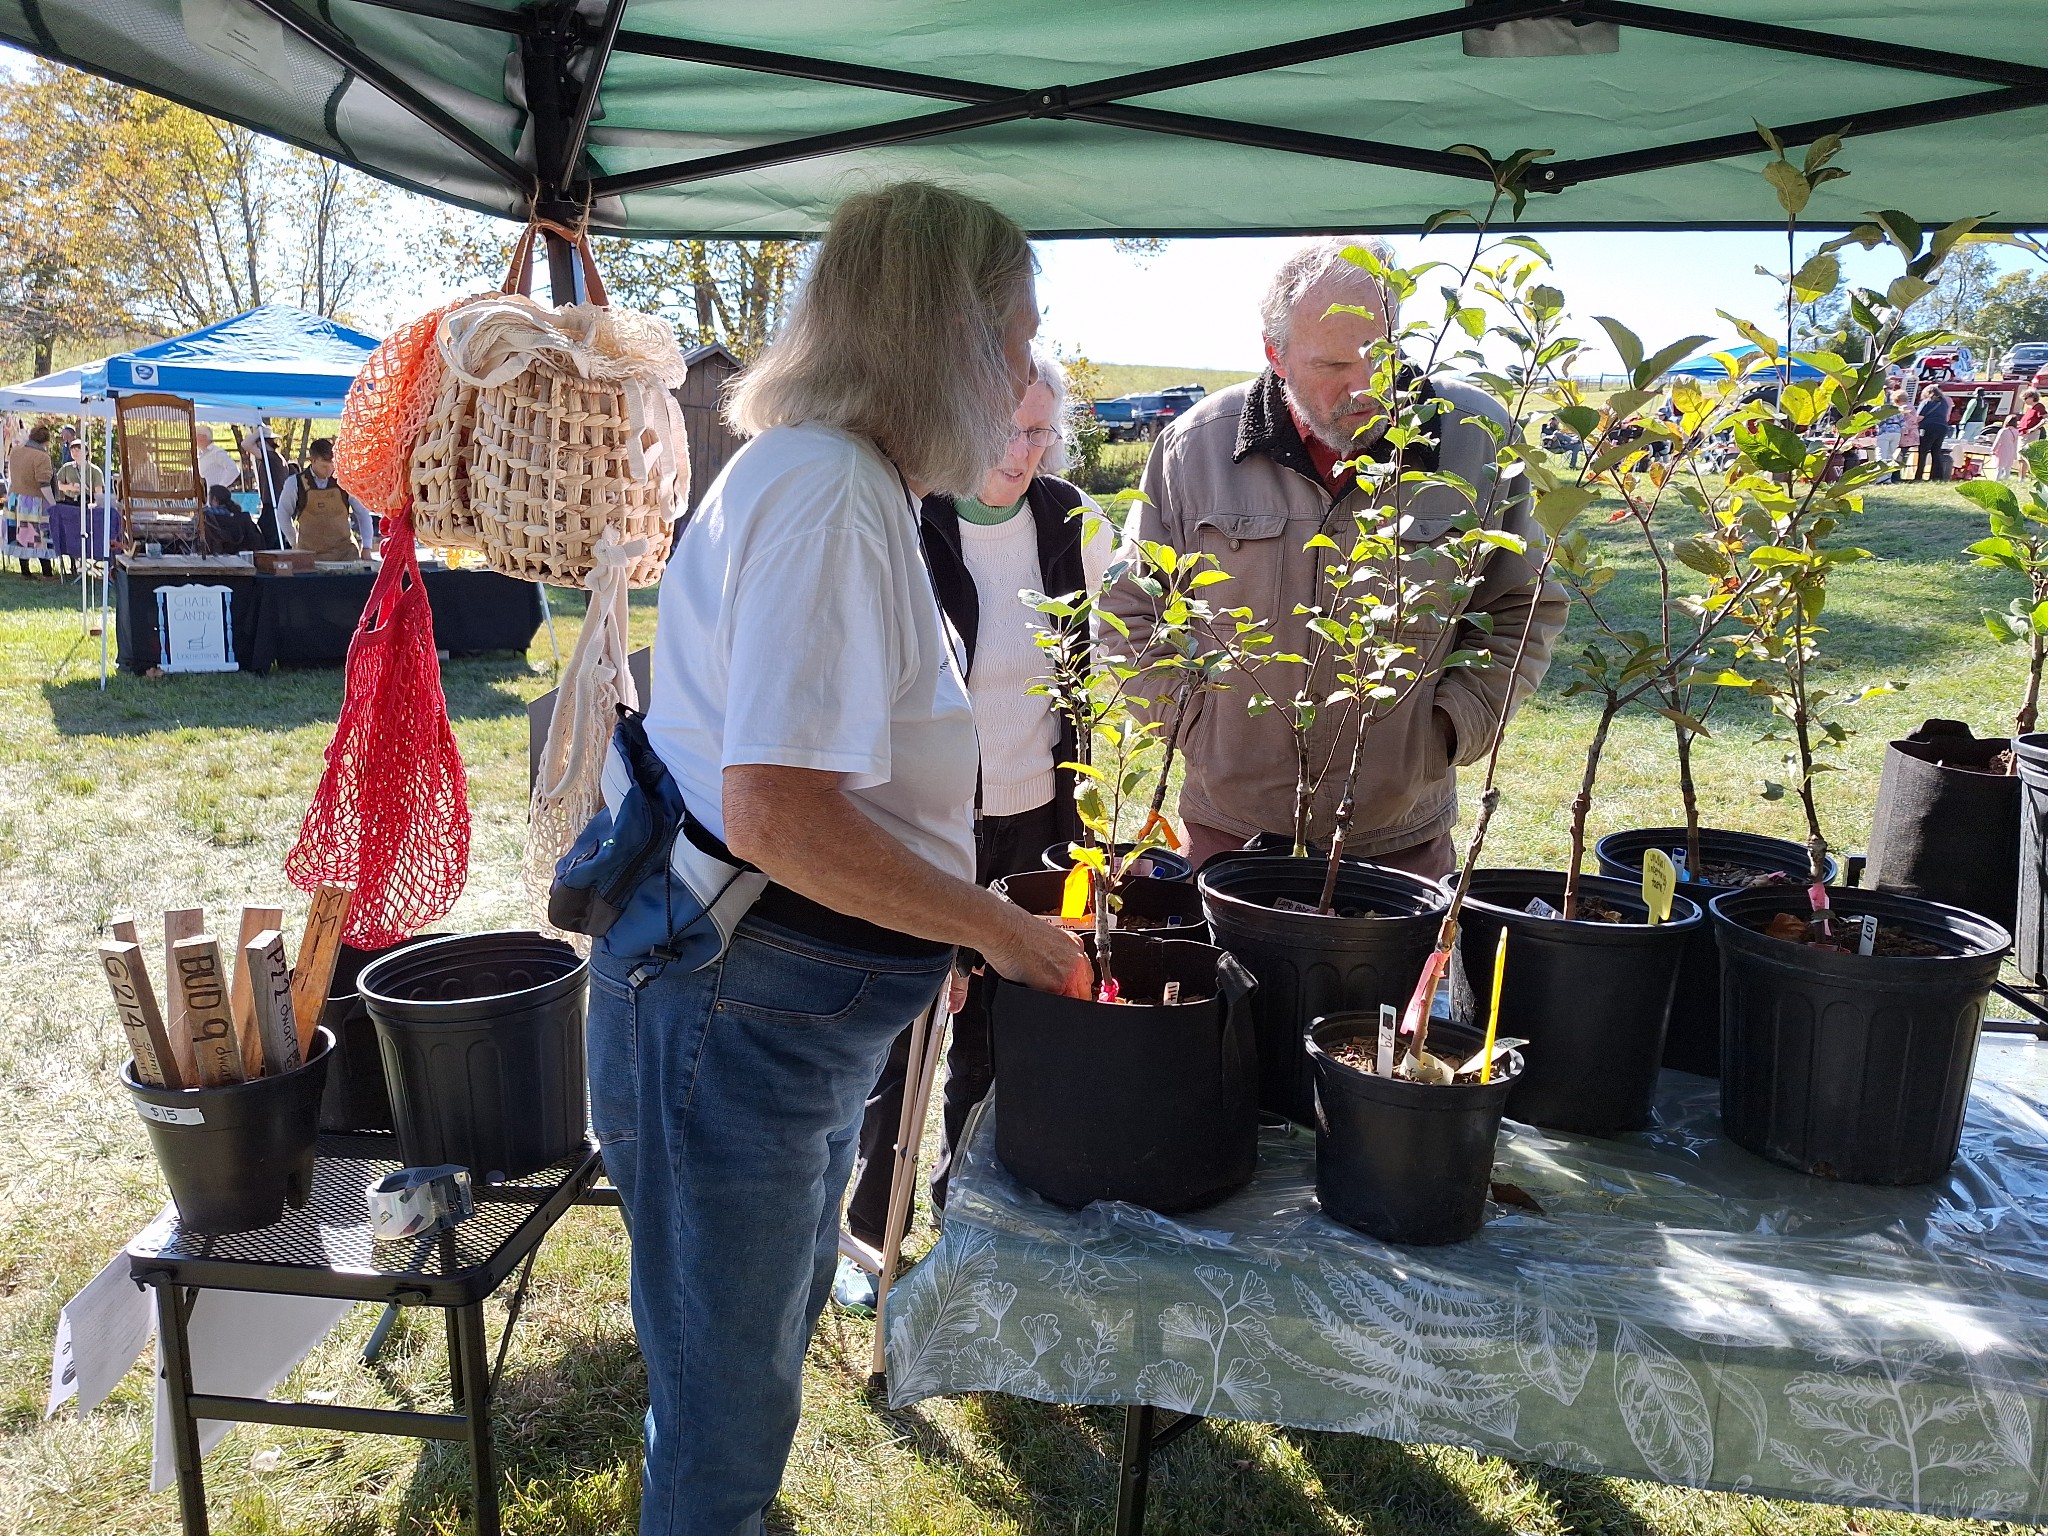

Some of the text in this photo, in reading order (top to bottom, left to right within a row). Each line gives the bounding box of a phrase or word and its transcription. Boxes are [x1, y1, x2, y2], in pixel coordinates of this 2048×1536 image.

[174, 594, 213, 607] CHAIR
[173, 608, 217, 621] CANING
[1863, 921, 1875, 942] 107
[179, 954, 222, 1010] BUD
[105, 956, 146, 1031] G214
[192, 1018, 229, 1042] 9
[1380, 1032, 1393, 1049] 29
[150, 1106, 178, 1121] $15
